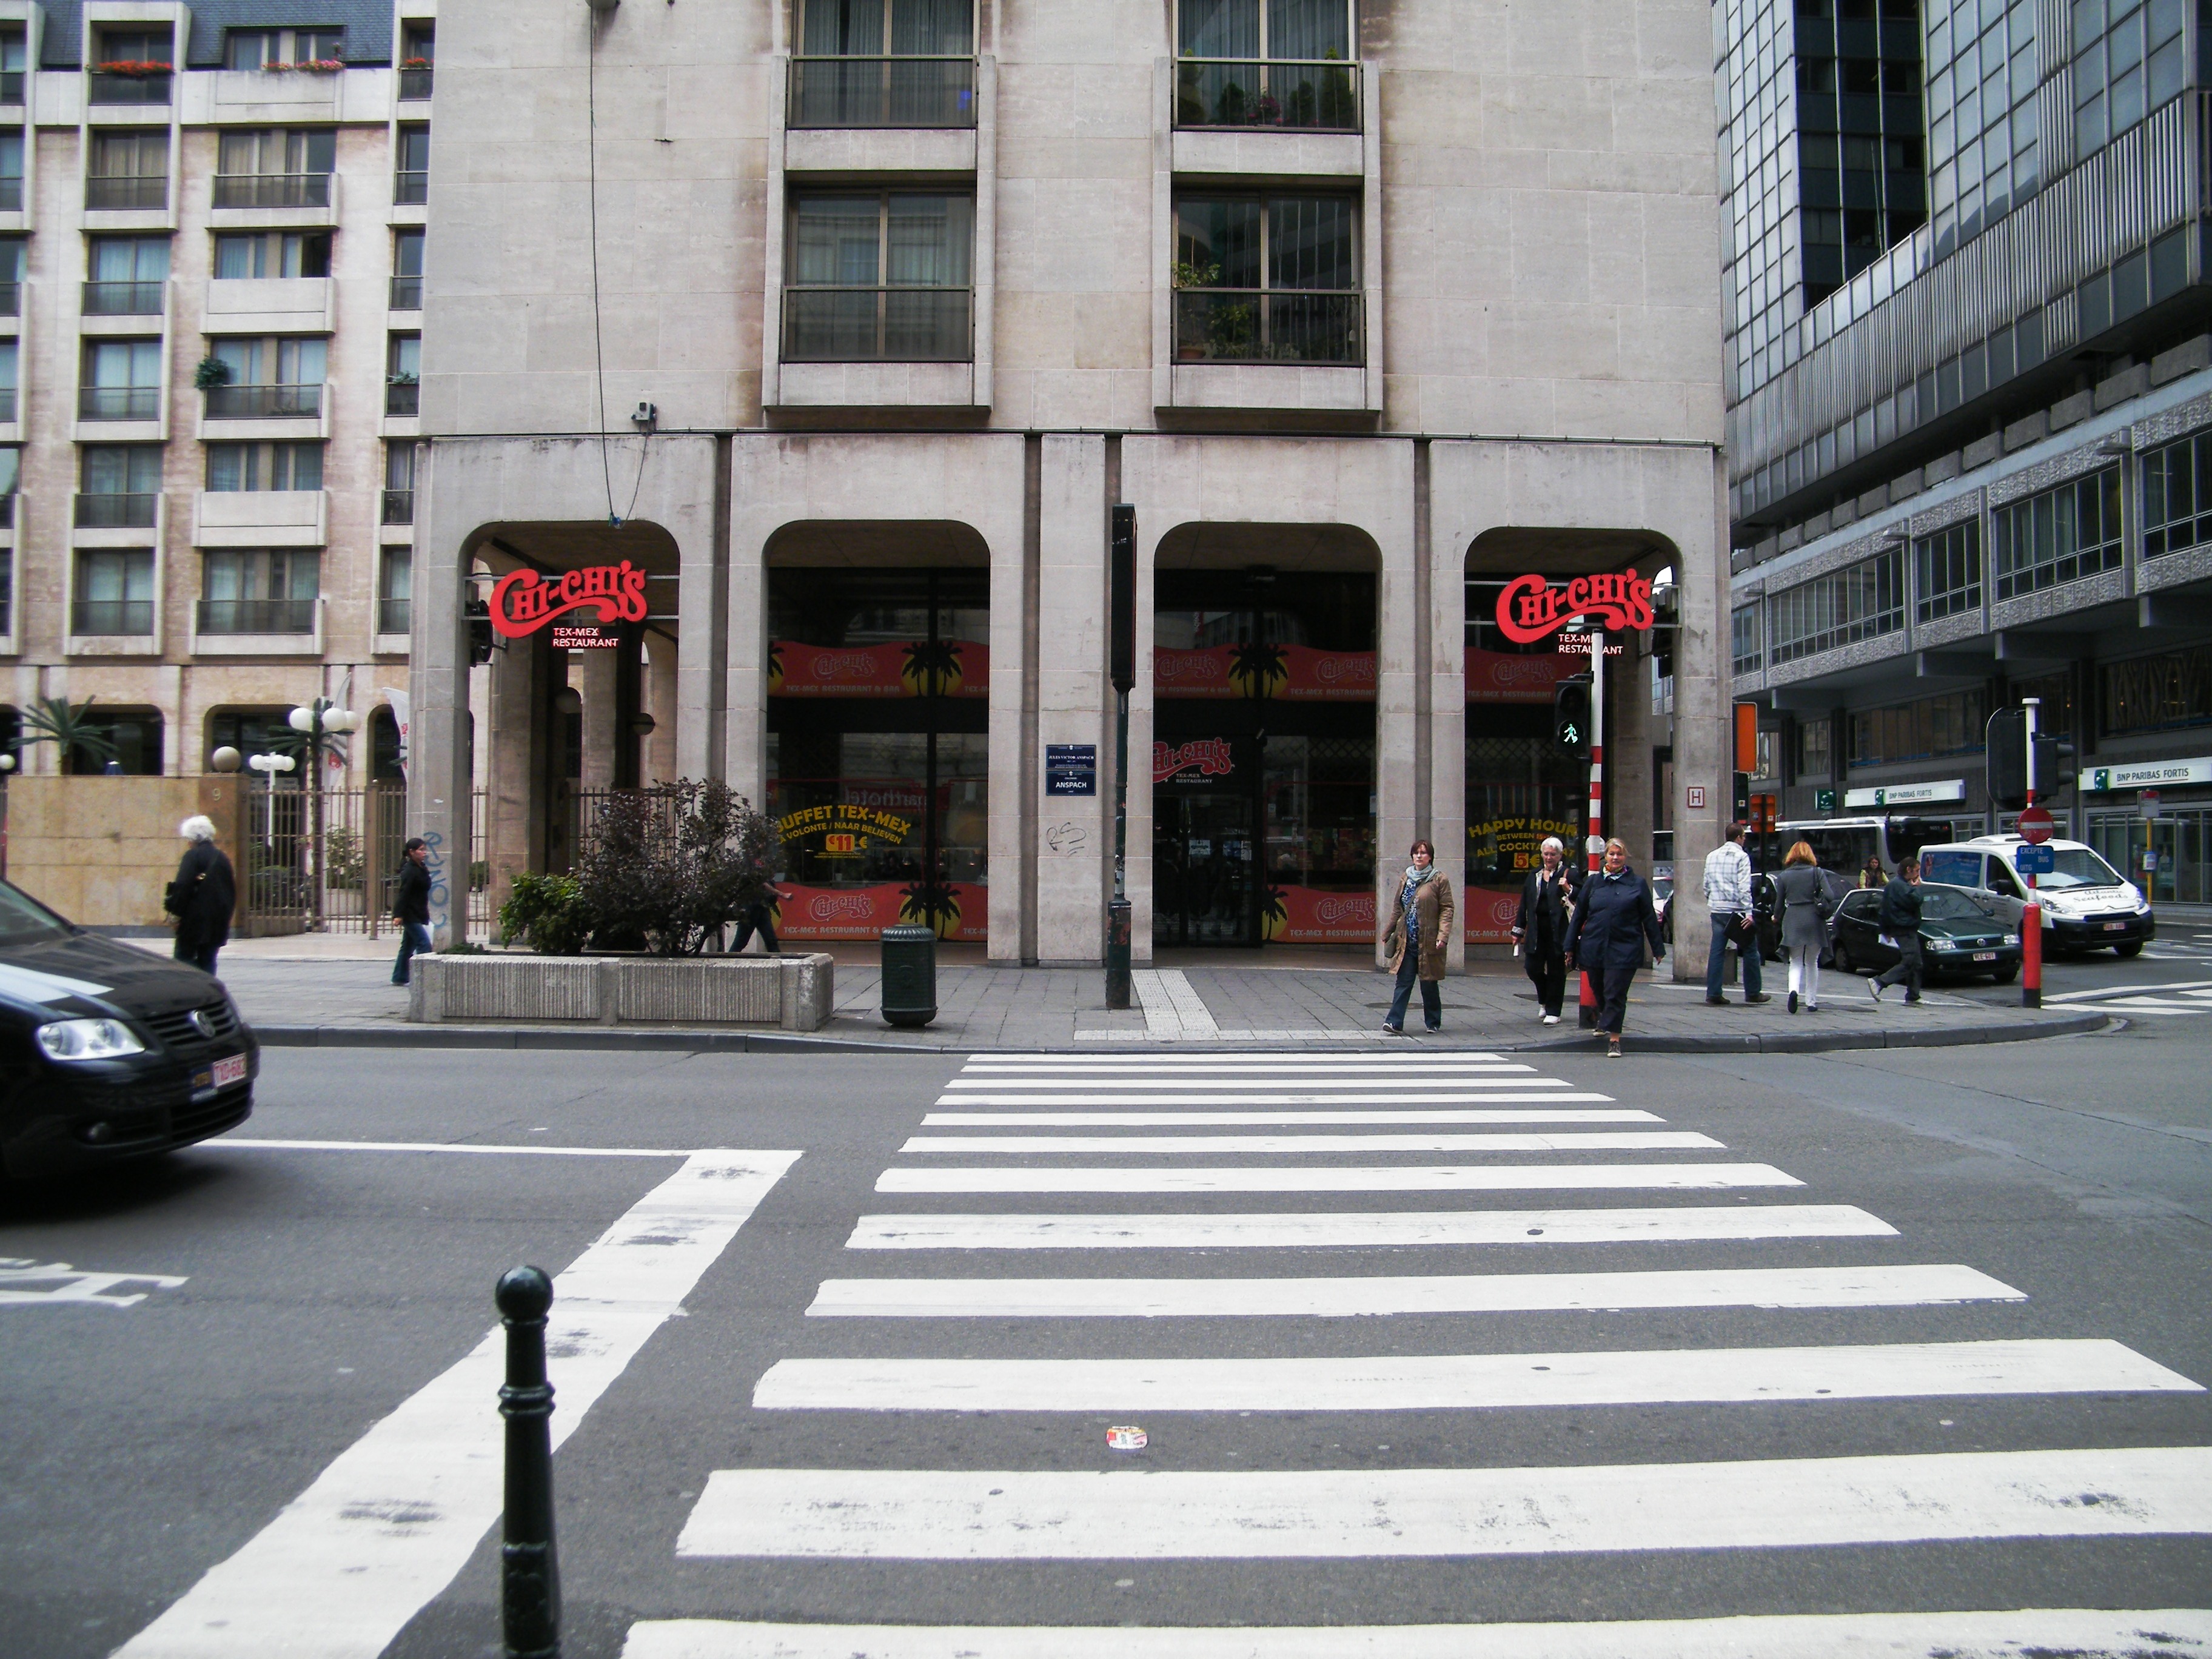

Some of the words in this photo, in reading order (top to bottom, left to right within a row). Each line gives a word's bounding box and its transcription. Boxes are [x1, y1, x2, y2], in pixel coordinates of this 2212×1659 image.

[553, 638, 618, 647] RESTAURANT
[1558, 634, 1592, 643] TEX-M
[1558, 645, 1623, 654] RESTAANT
[2117, 773, 2131, 782] BNP
[2132, 770, 2160, 780] PARIBAS
[2163, 768, 2188, 778] FORTIS
[213, 788, 221, 801] 9
[1691, 791, 1701, 803] H
[837, 805, 911, 835] TEX-MEX
[786, 823, 827, 839] VOLONTE
[834, 822, 860, 830] NAAR
[861, 824, 902, 844] BELIEVEN
[1468, 819, 1526, 837] HAPPY
[1530, 819, 1577, 836] HOUR
[1496, 833, 1535, 841] BETWEEN
[1476, 847, 1497, 857] ALL
[1499, 842, 1542, 851] COCKTA
[1515, 853, 1527, 867] 5
[2073, 894, 2128, 902] Seafoods
